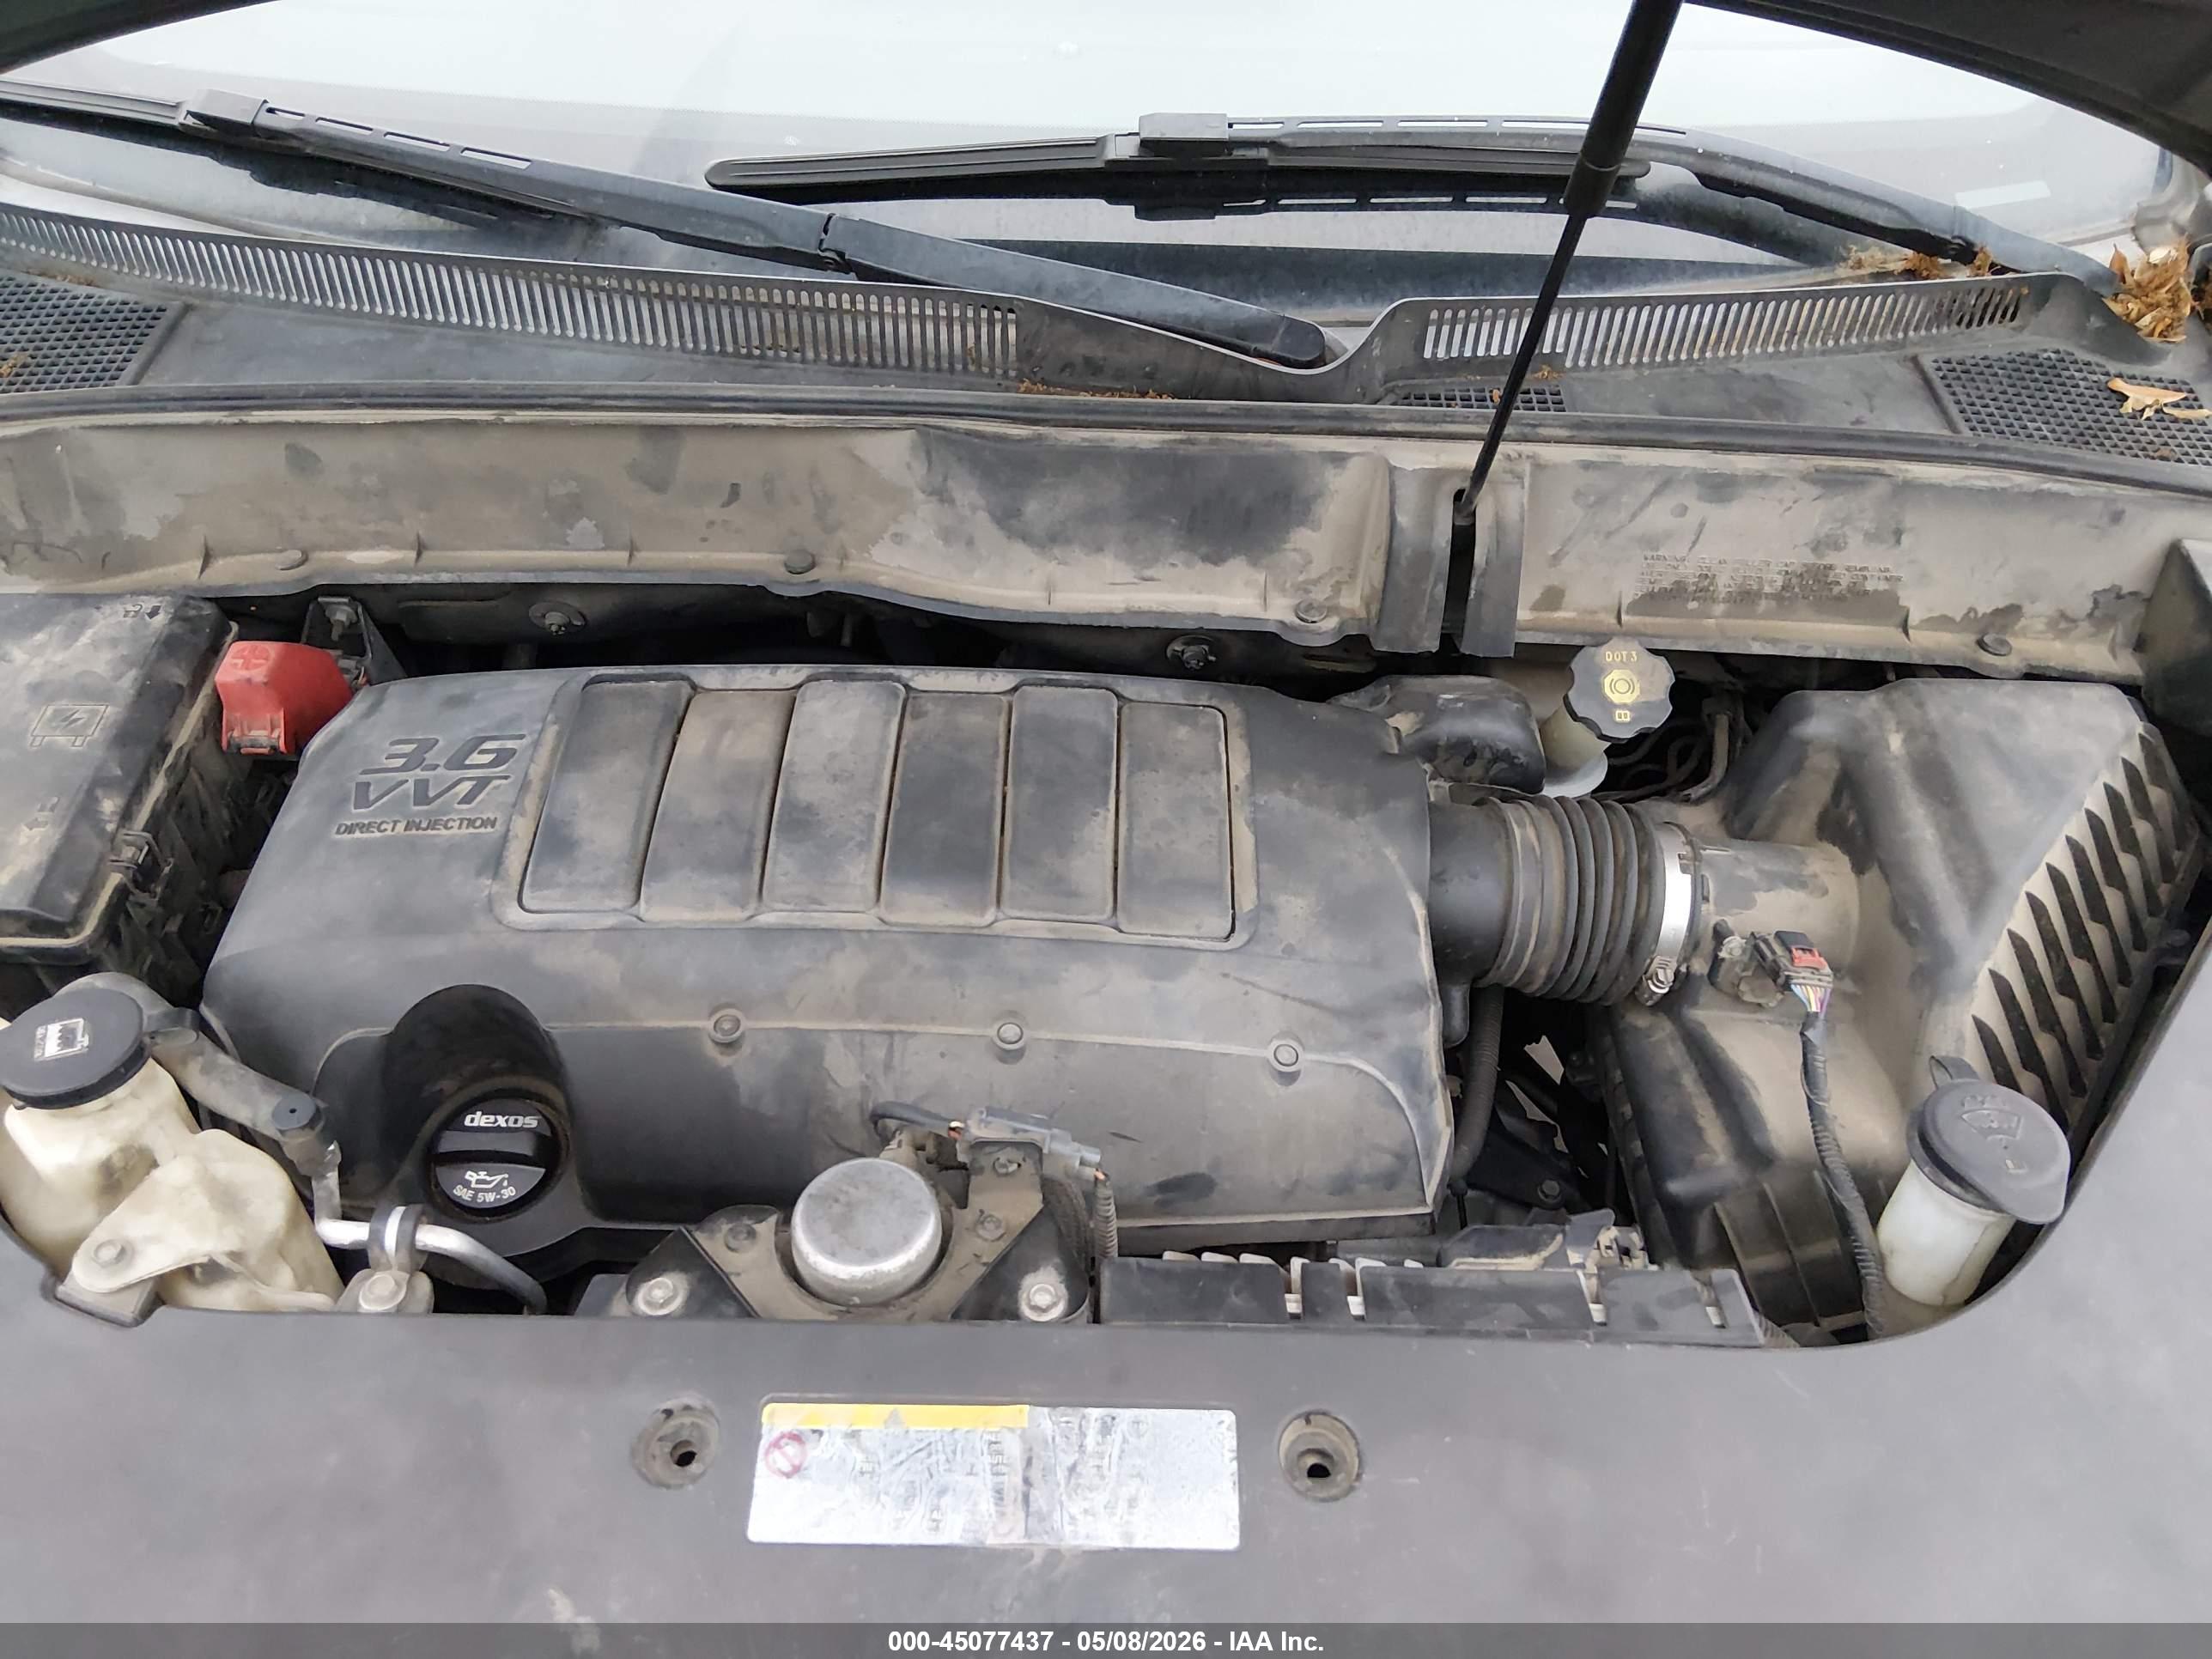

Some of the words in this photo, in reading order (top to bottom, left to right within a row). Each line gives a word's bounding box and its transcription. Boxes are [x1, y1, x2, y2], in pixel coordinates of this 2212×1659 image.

[1606, 651, 1627, 661] DOT
[1631, 651, 1638, 661] 3
[359, 734, 526, 775] 3.6
[353, 775, 511, 810] VVT
[335, 819, 399, 835] DIRECT
[404, 817, 498, 832] INJECTION
[464, 1110, 538, 1128] dexos
[453, 1184, 475, 1201] SAE
[477, 1186, 516, 1203] 5W-30
